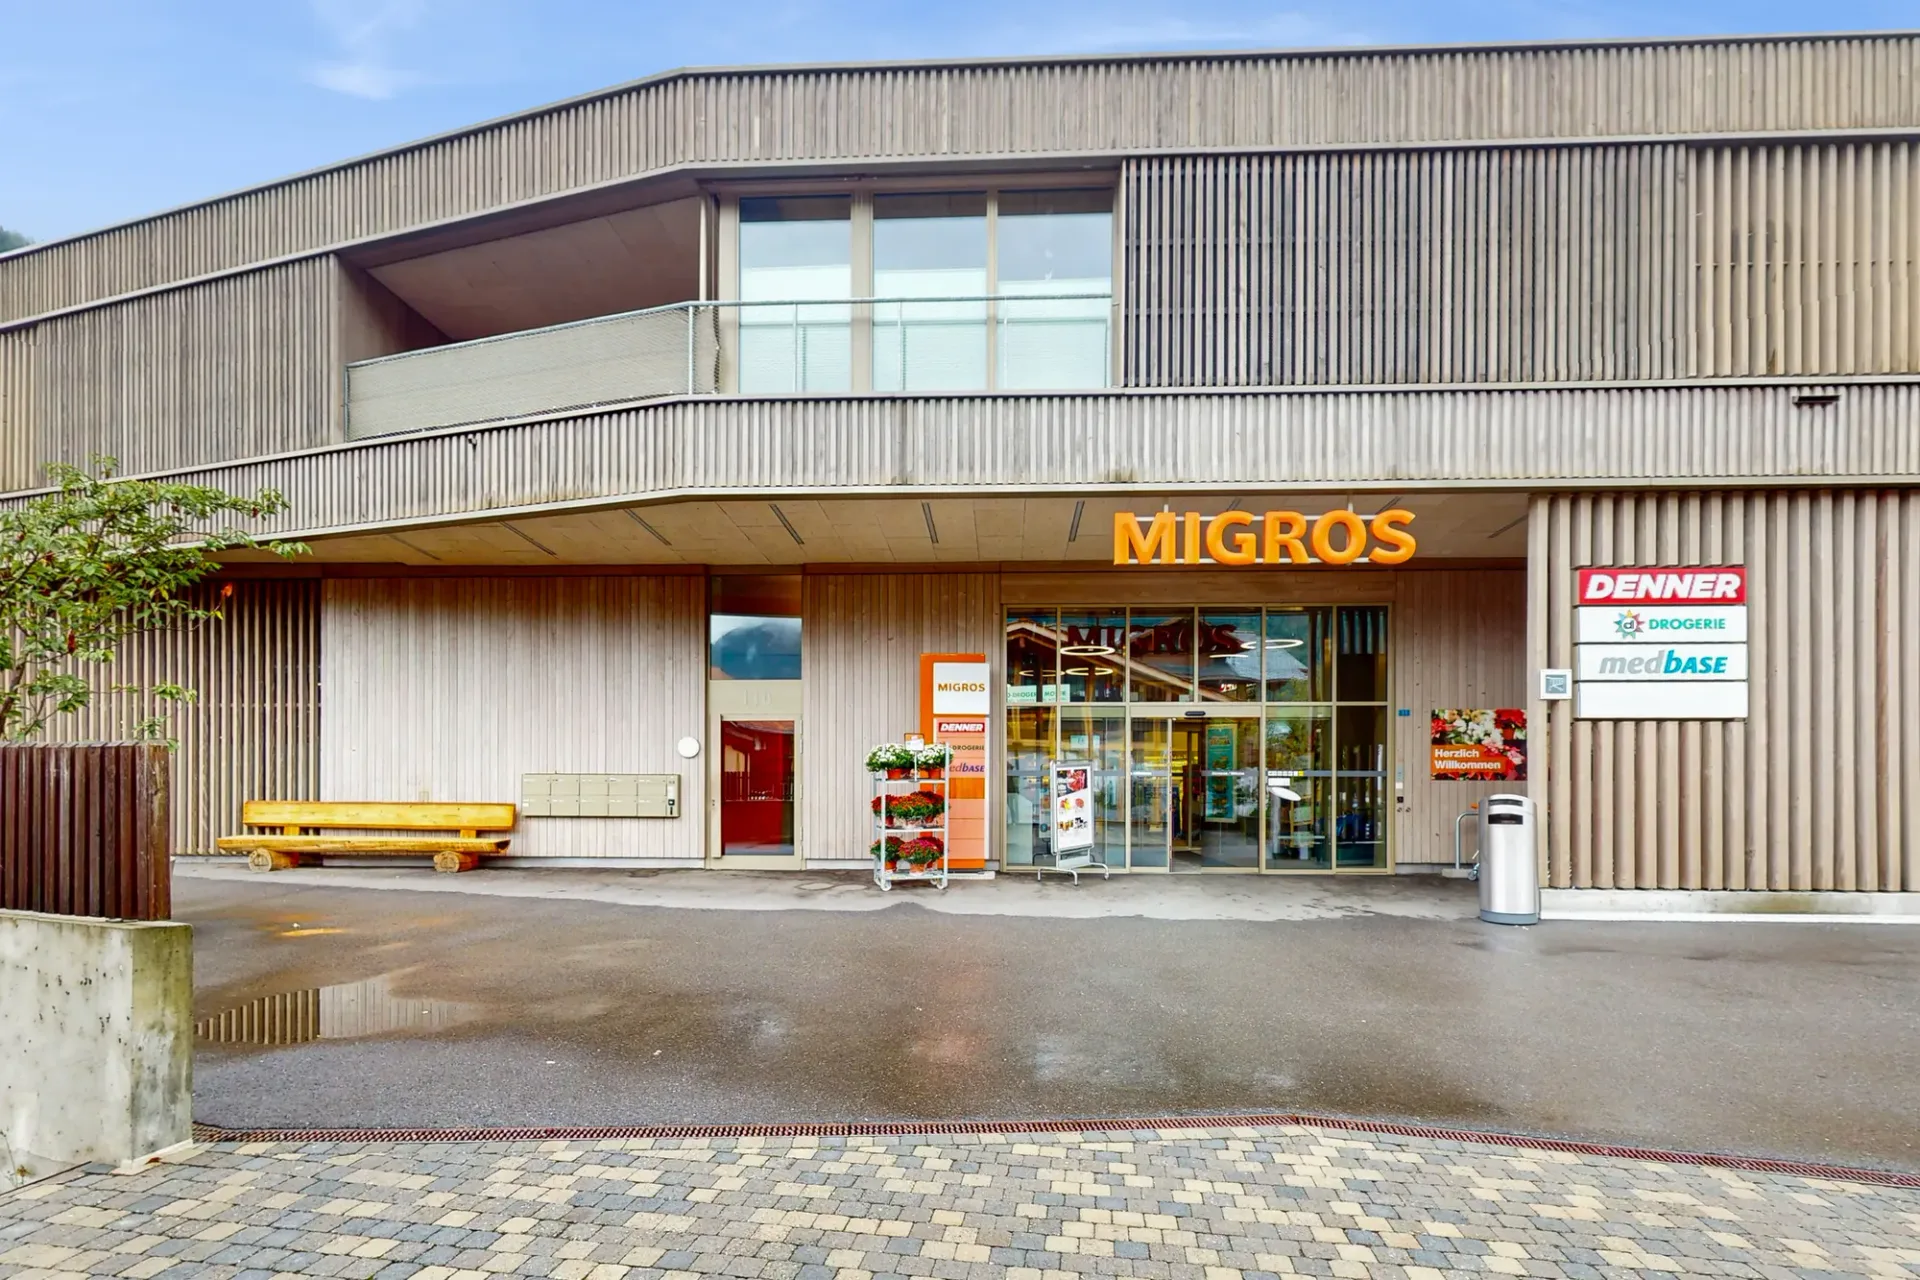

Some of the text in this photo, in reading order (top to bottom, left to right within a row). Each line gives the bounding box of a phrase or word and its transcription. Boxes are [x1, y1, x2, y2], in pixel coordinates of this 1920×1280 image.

[1113, 509, 1417, 565] MIGROS
[1585, 574, 1742, 600] DENNER
[1649, 618, 1726, 630] DROGERIE
[938, 683, 986, 692] MIGROS
[940, 723, 984, 732] DENNER
[1435, 748, 1479, 758] Herzlich
[1435, 760, 1501, 770] Willkommen
